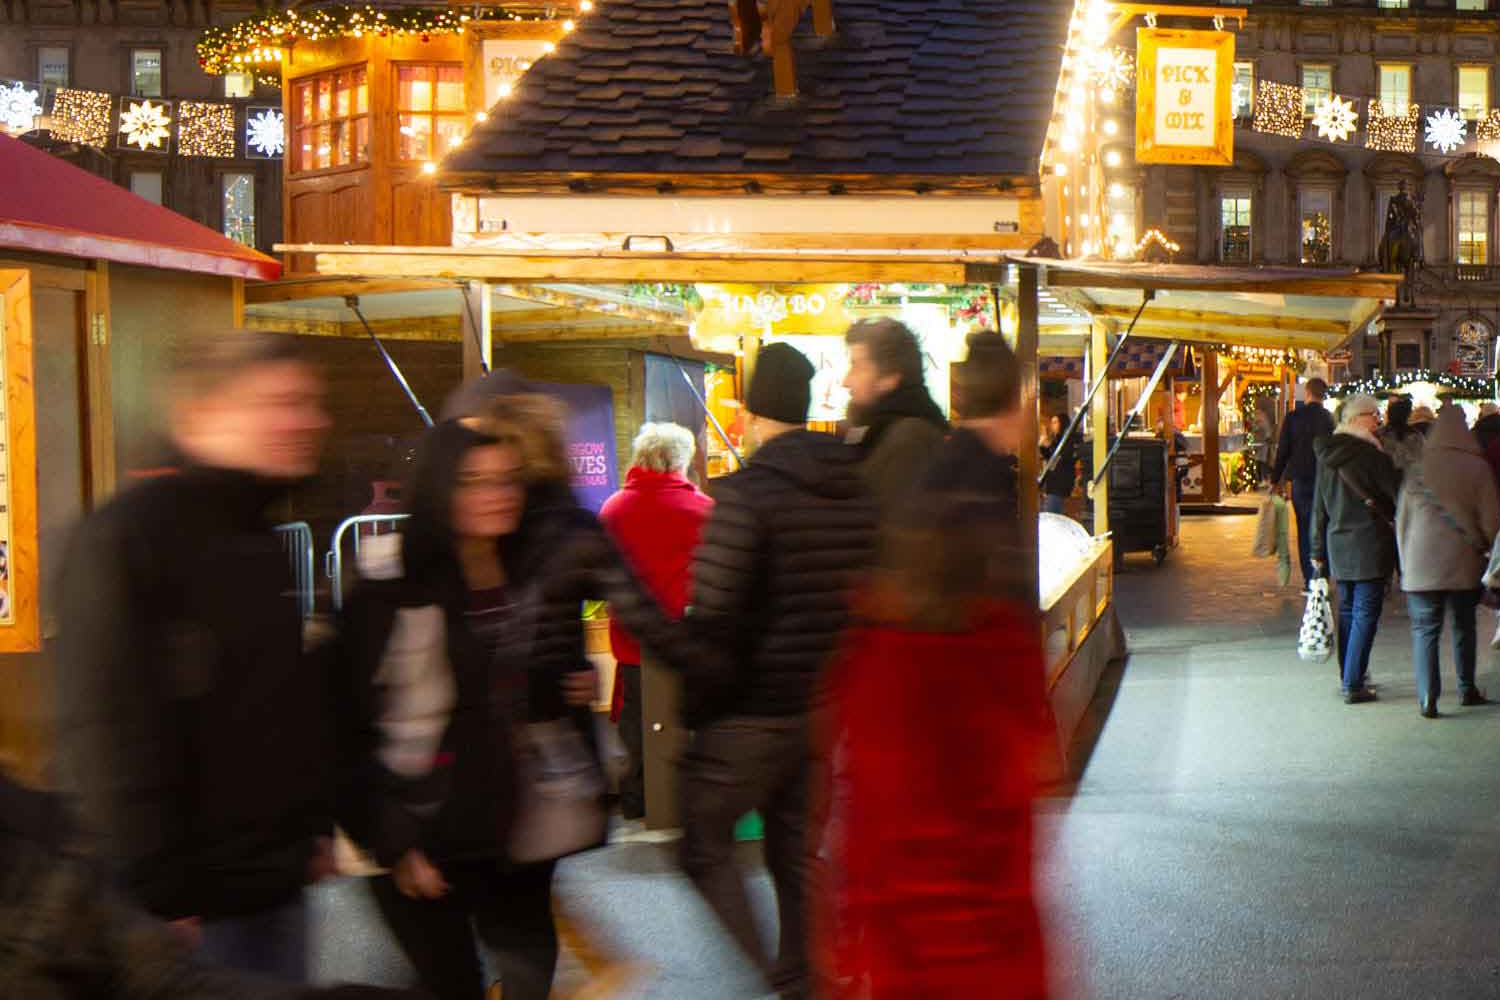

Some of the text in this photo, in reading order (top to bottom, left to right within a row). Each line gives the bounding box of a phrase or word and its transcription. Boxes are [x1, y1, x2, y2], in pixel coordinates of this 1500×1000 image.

[1161, 65, 1211, 83] PICK
[1178, 87, 1193, 107] &
[1165, 111, 1206, 130] MIX
